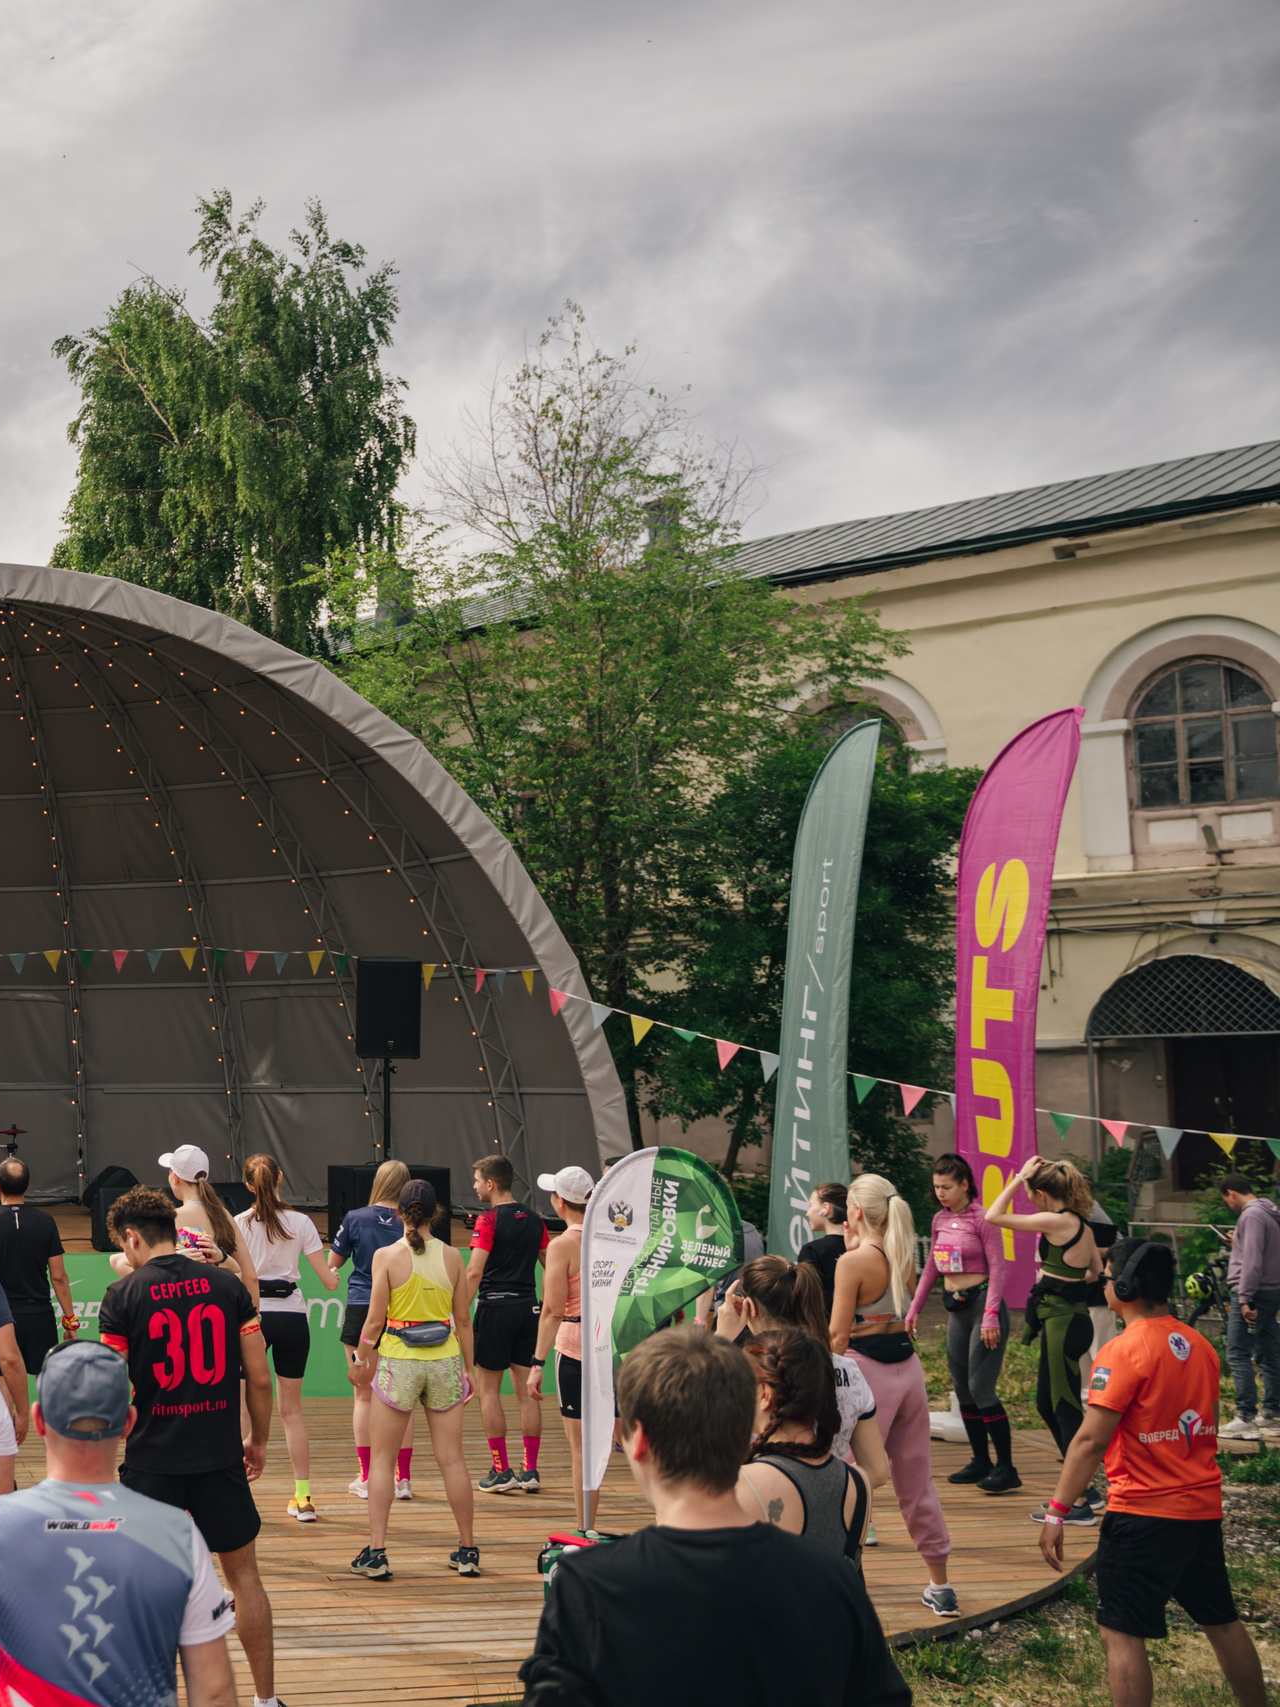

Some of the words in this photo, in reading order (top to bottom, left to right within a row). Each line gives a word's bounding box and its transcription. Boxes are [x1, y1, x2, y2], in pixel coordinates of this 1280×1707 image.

[631, 1180, 680, 1296] ТРЕНИРОВКИ
[680, 1239, 731, 1258] ЗЕЛЕНЫЙ
[680, 1253, 727, 1268] ФИТНЕС
[150, 1277, 211, 1300] СЕРГЕЕВ
[148, 1302, 226, 1391] 30
[151, 1400, 227, 1418] ritmsport.ru
[1138, 1428, 1180, 1444] ВПЕРЕД
